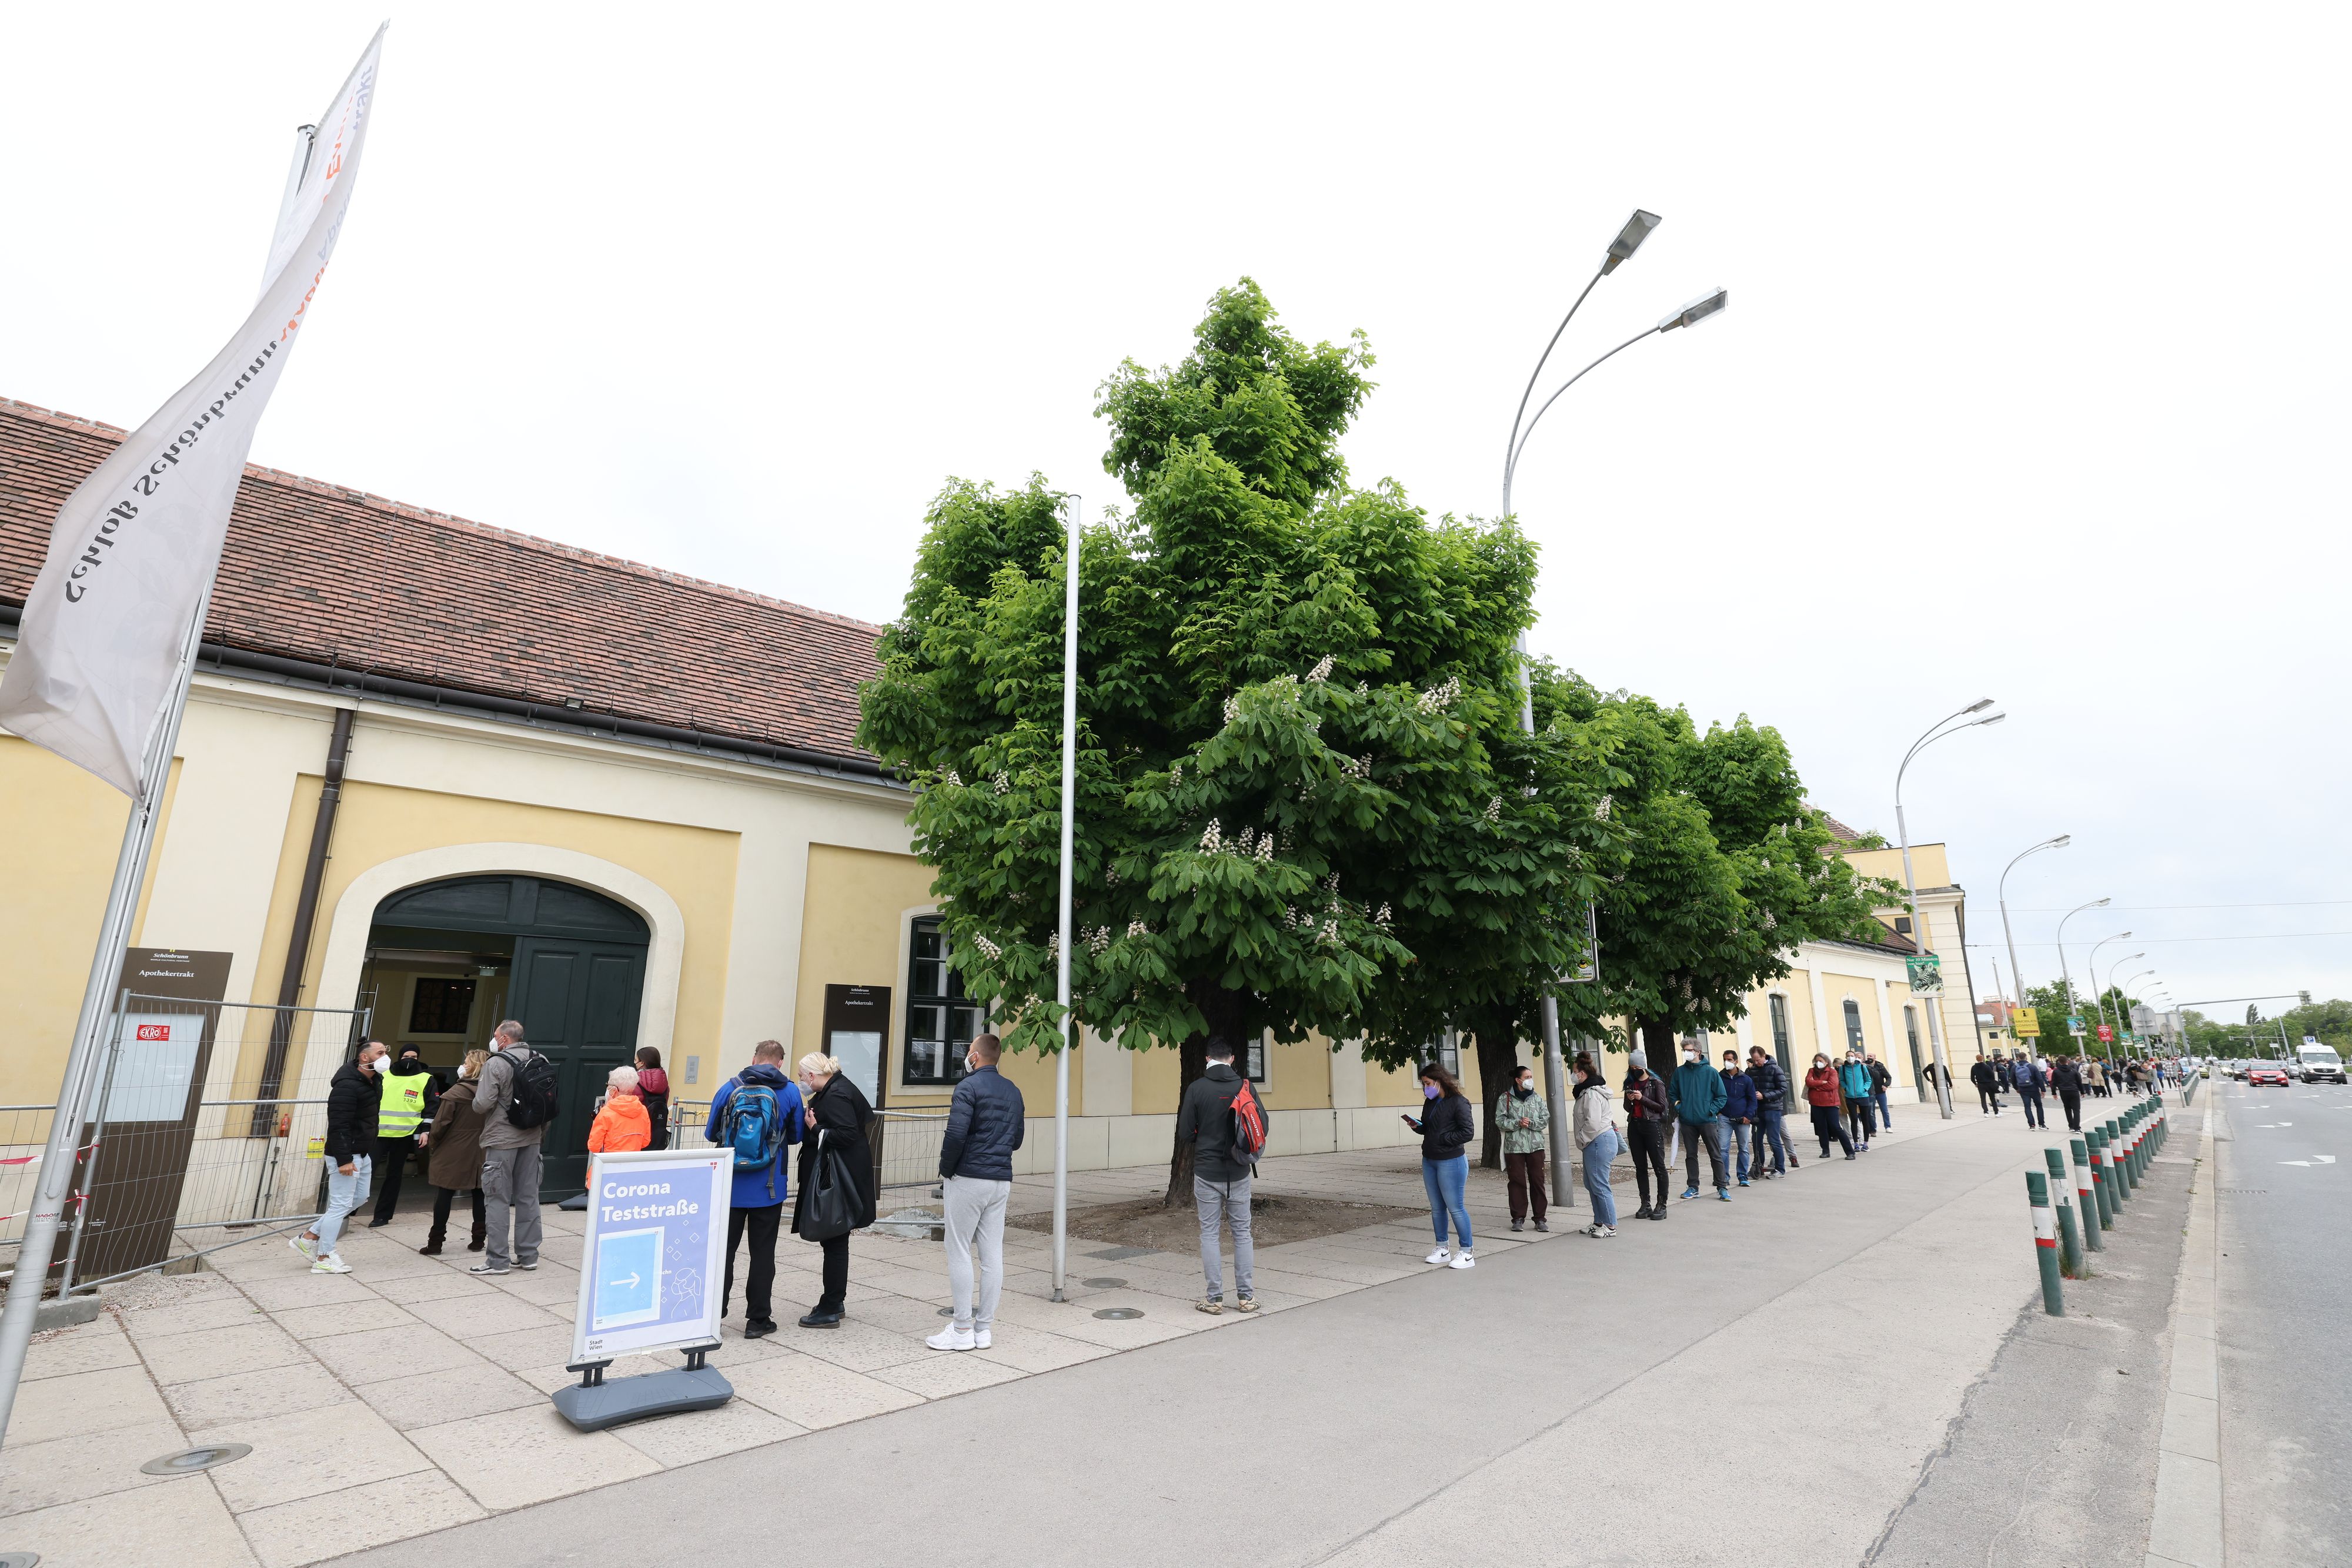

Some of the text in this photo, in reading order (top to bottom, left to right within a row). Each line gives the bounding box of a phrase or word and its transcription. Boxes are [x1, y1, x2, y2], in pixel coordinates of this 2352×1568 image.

[139, 969, 195, 978] Apothekertrakt
[141, 1028, 159, 1038] EKRO
[1250, 1114, 1260, 1137] SALOMON
[603, 1182, 671, 1199] Corona
[602, 1199, 699, 1222] Teststraße
